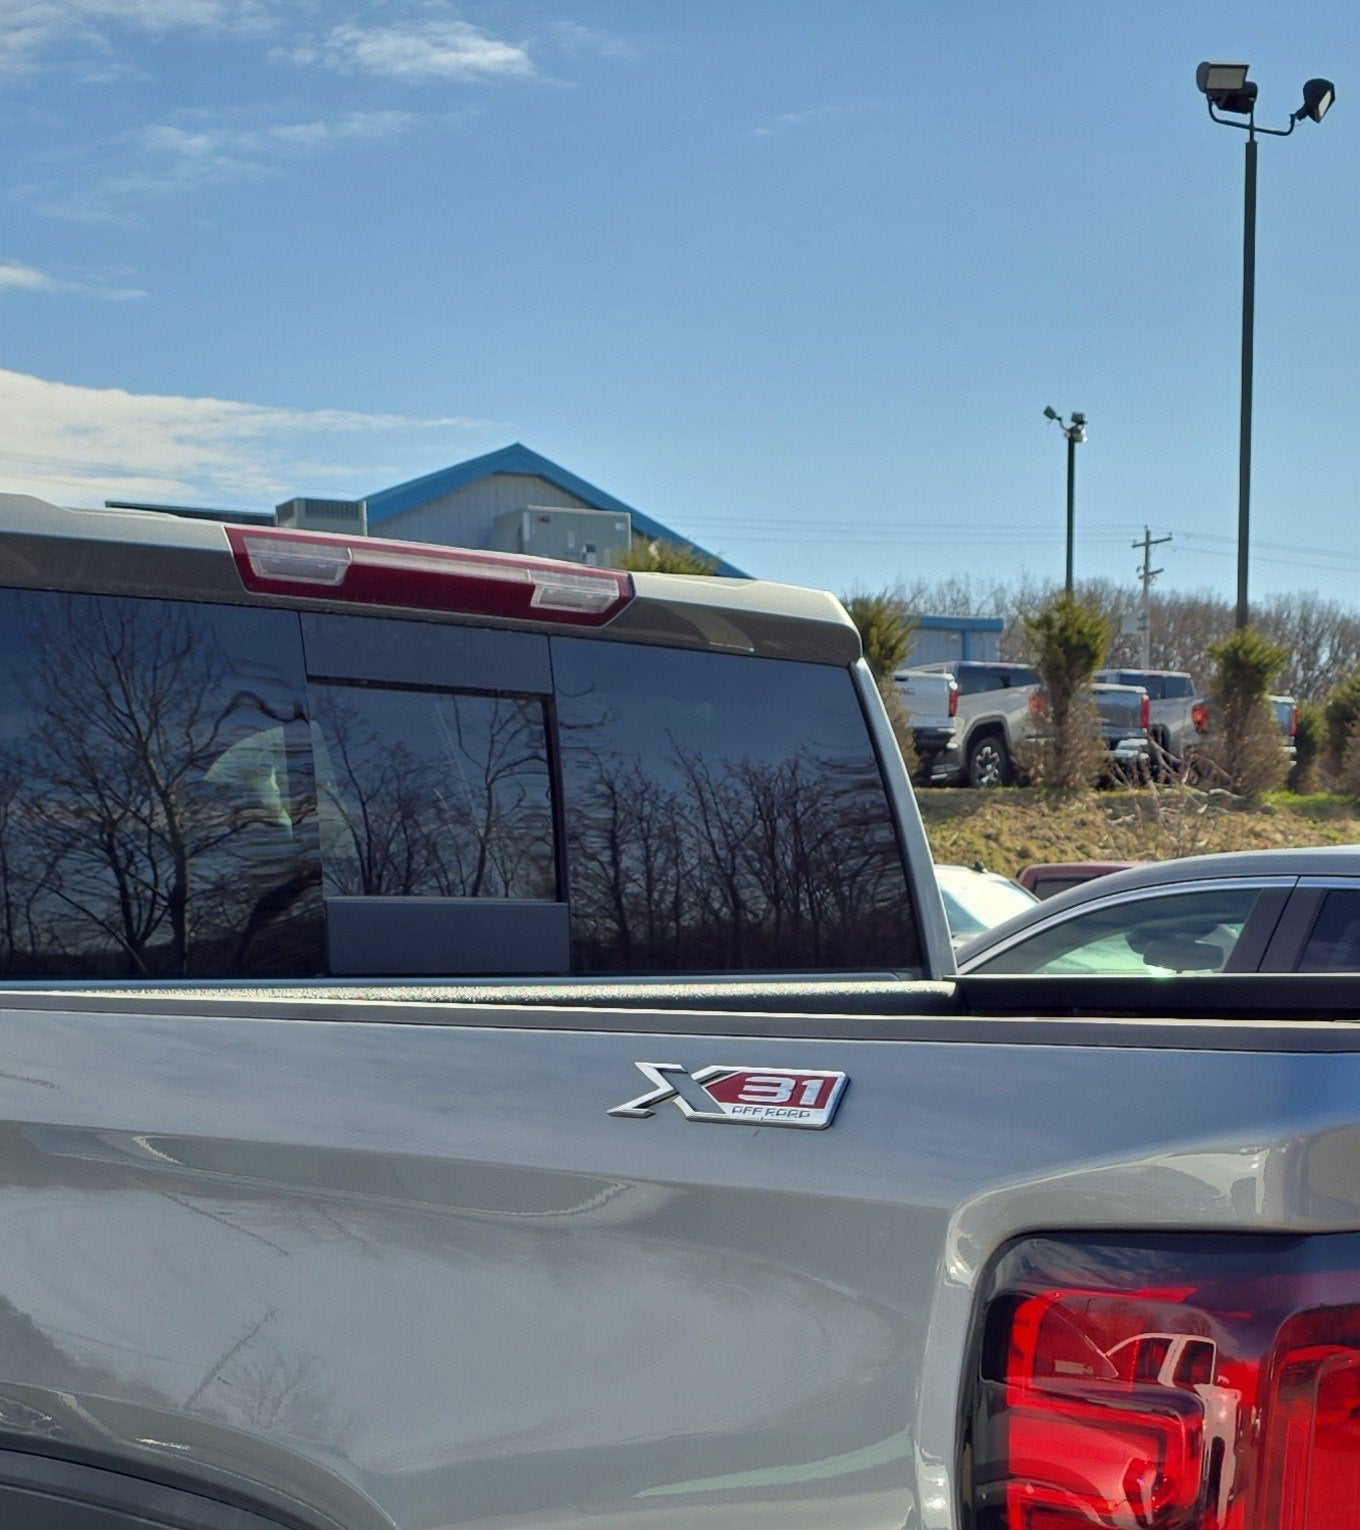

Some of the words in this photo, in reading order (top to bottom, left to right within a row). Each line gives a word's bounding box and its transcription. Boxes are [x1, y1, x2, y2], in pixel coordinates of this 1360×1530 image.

[606, 1061, 830, 1121] X31
[732, 1106, 763, 1116] OFF
[764, 1107, 811, 1119] ROAD
